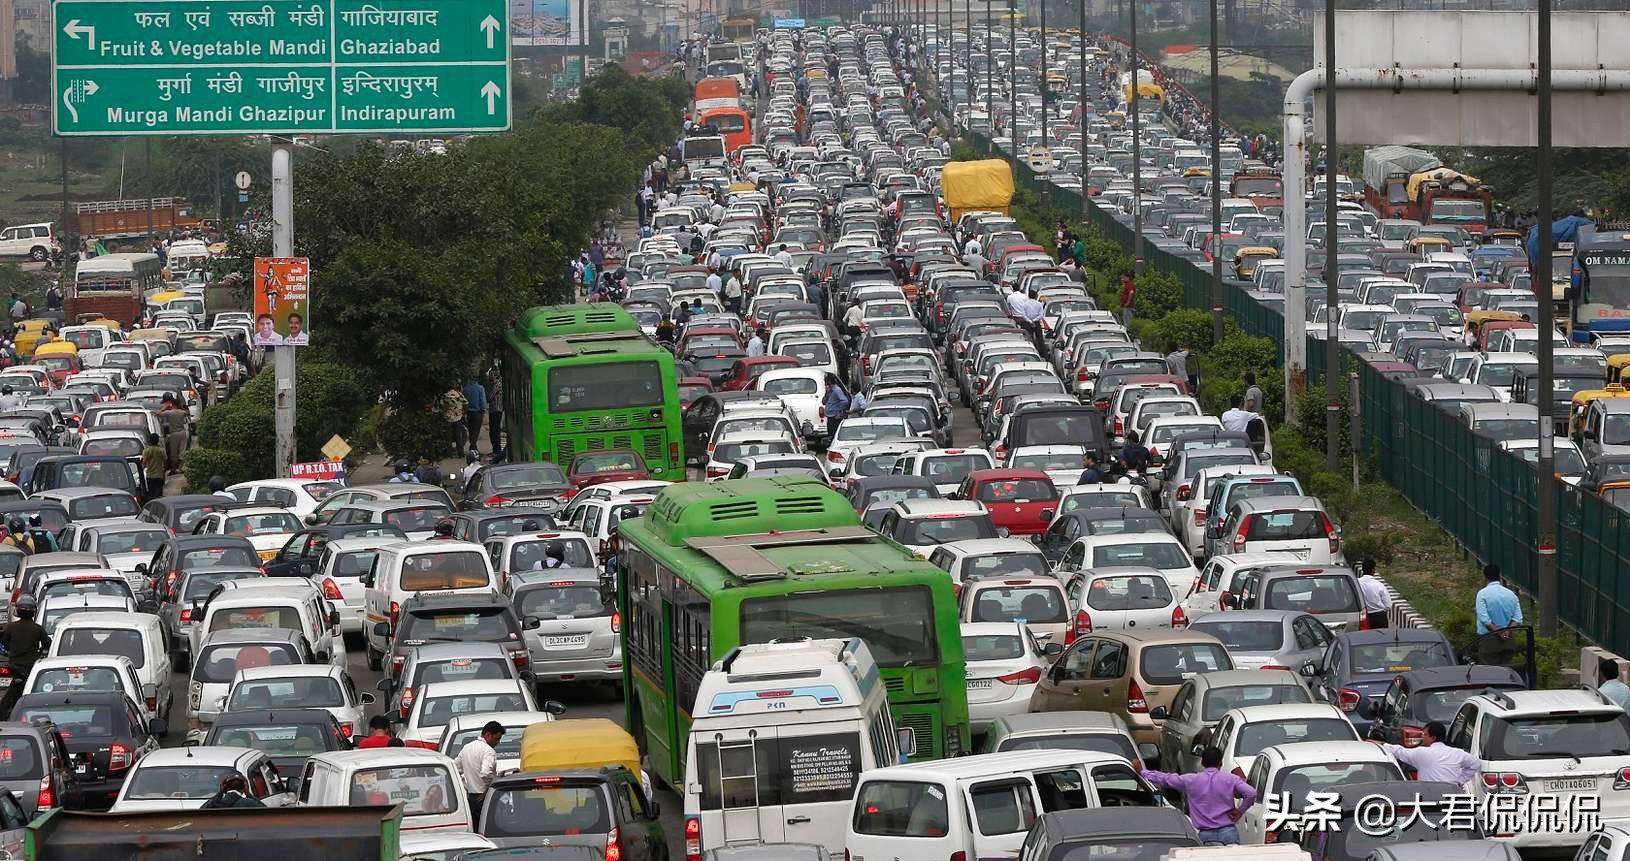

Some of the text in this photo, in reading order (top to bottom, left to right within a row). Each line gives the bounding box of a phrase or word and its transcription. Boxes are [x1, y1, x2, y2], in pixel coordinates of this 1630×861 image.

[135, 4, 325, 30] फल एवं सब्जी मंडी
[341, 4, 438, 27] गाजियाबाद
[100, 40, 326, 60] Fruit & Vegetable Mandi
[340, 38, 440, 56] Ghaziabad
[157, 71, 325, 101] मुर्गा मंडी गाजीपुर
[341, 70, 438, 99] इन्दिरापुरम्
[107, 105, 326, 126] Murga Mandi Ghazipur
[341, 106, 455, 124] Indirapuram
[1585, 256, 1601, 265] OM
[292, 464, 305, 475] UP
[328, 462, 344, 472] TAX
